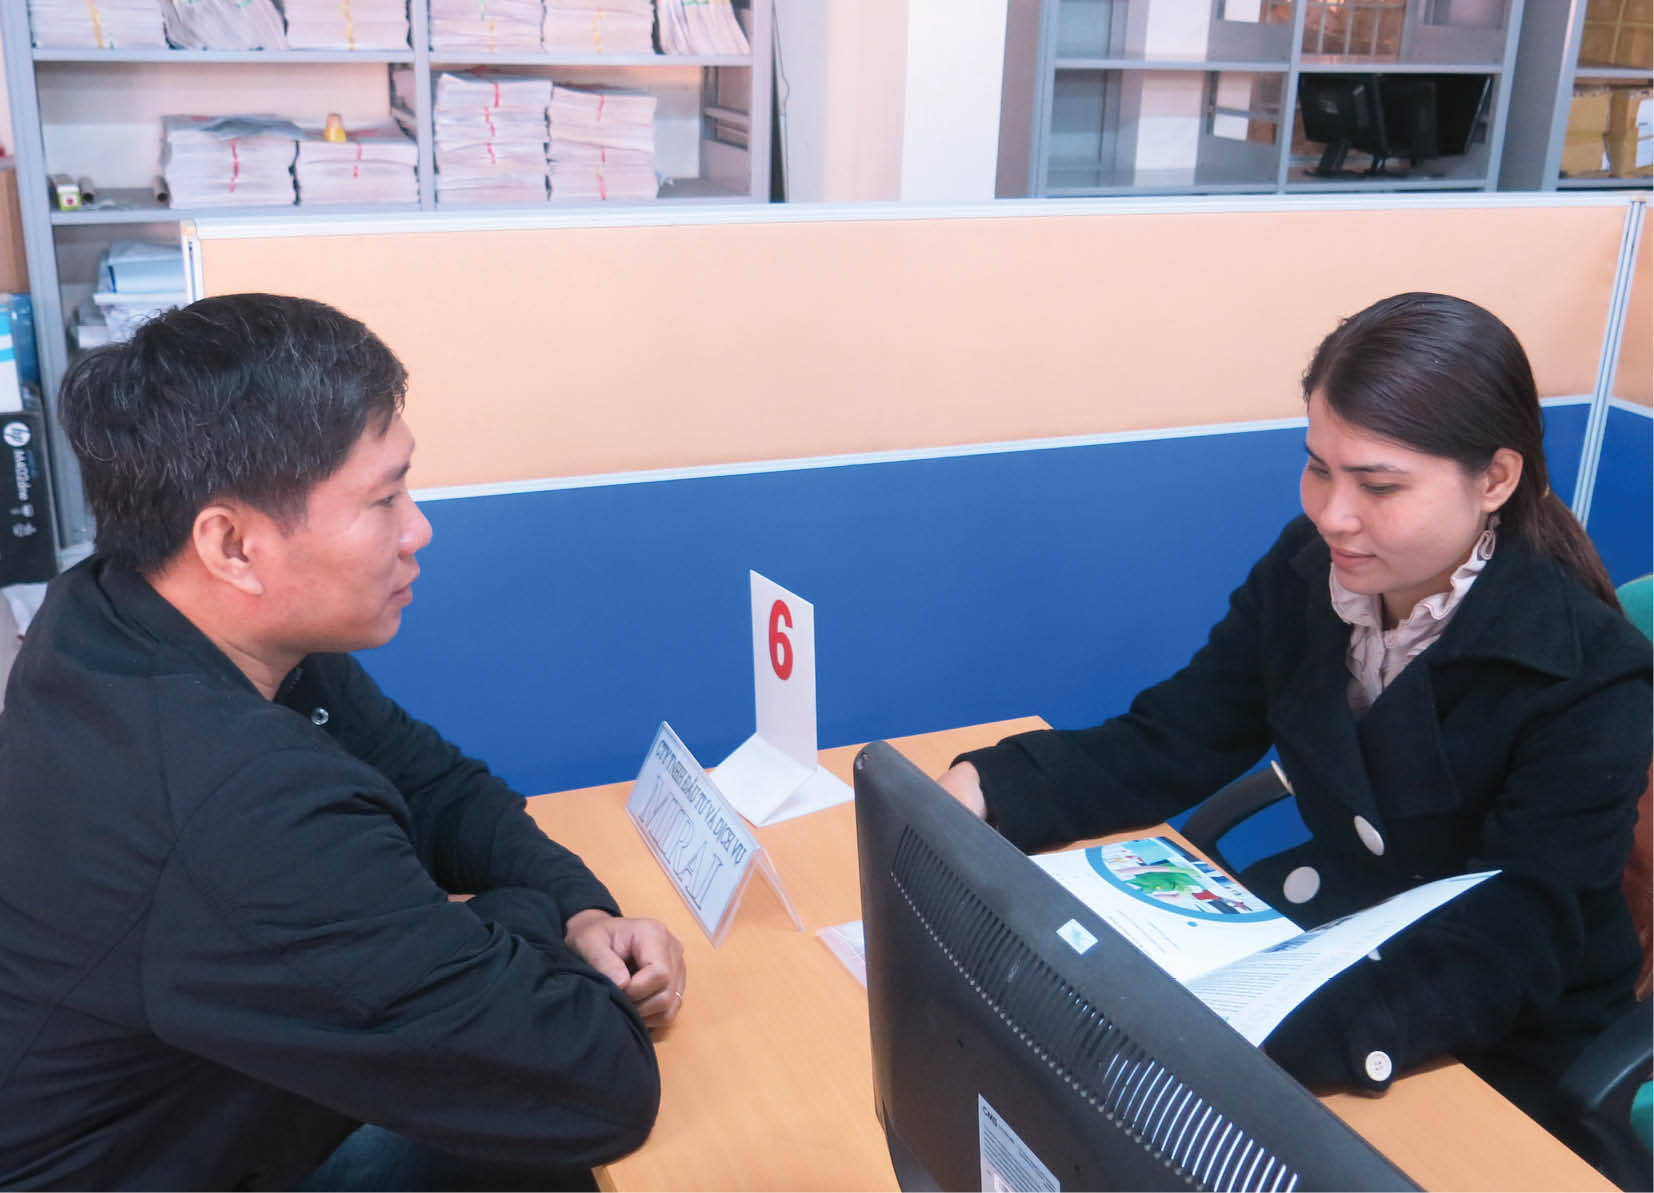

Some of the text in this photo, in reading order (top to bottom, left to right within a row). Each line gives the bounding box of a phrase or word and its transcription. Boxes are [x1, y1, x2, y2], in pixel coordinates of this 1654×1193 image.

[769, 600, 793, 680] 6
[656, 739, 672, 765] CTY
[638, 775, 722, 911] MIRAI
